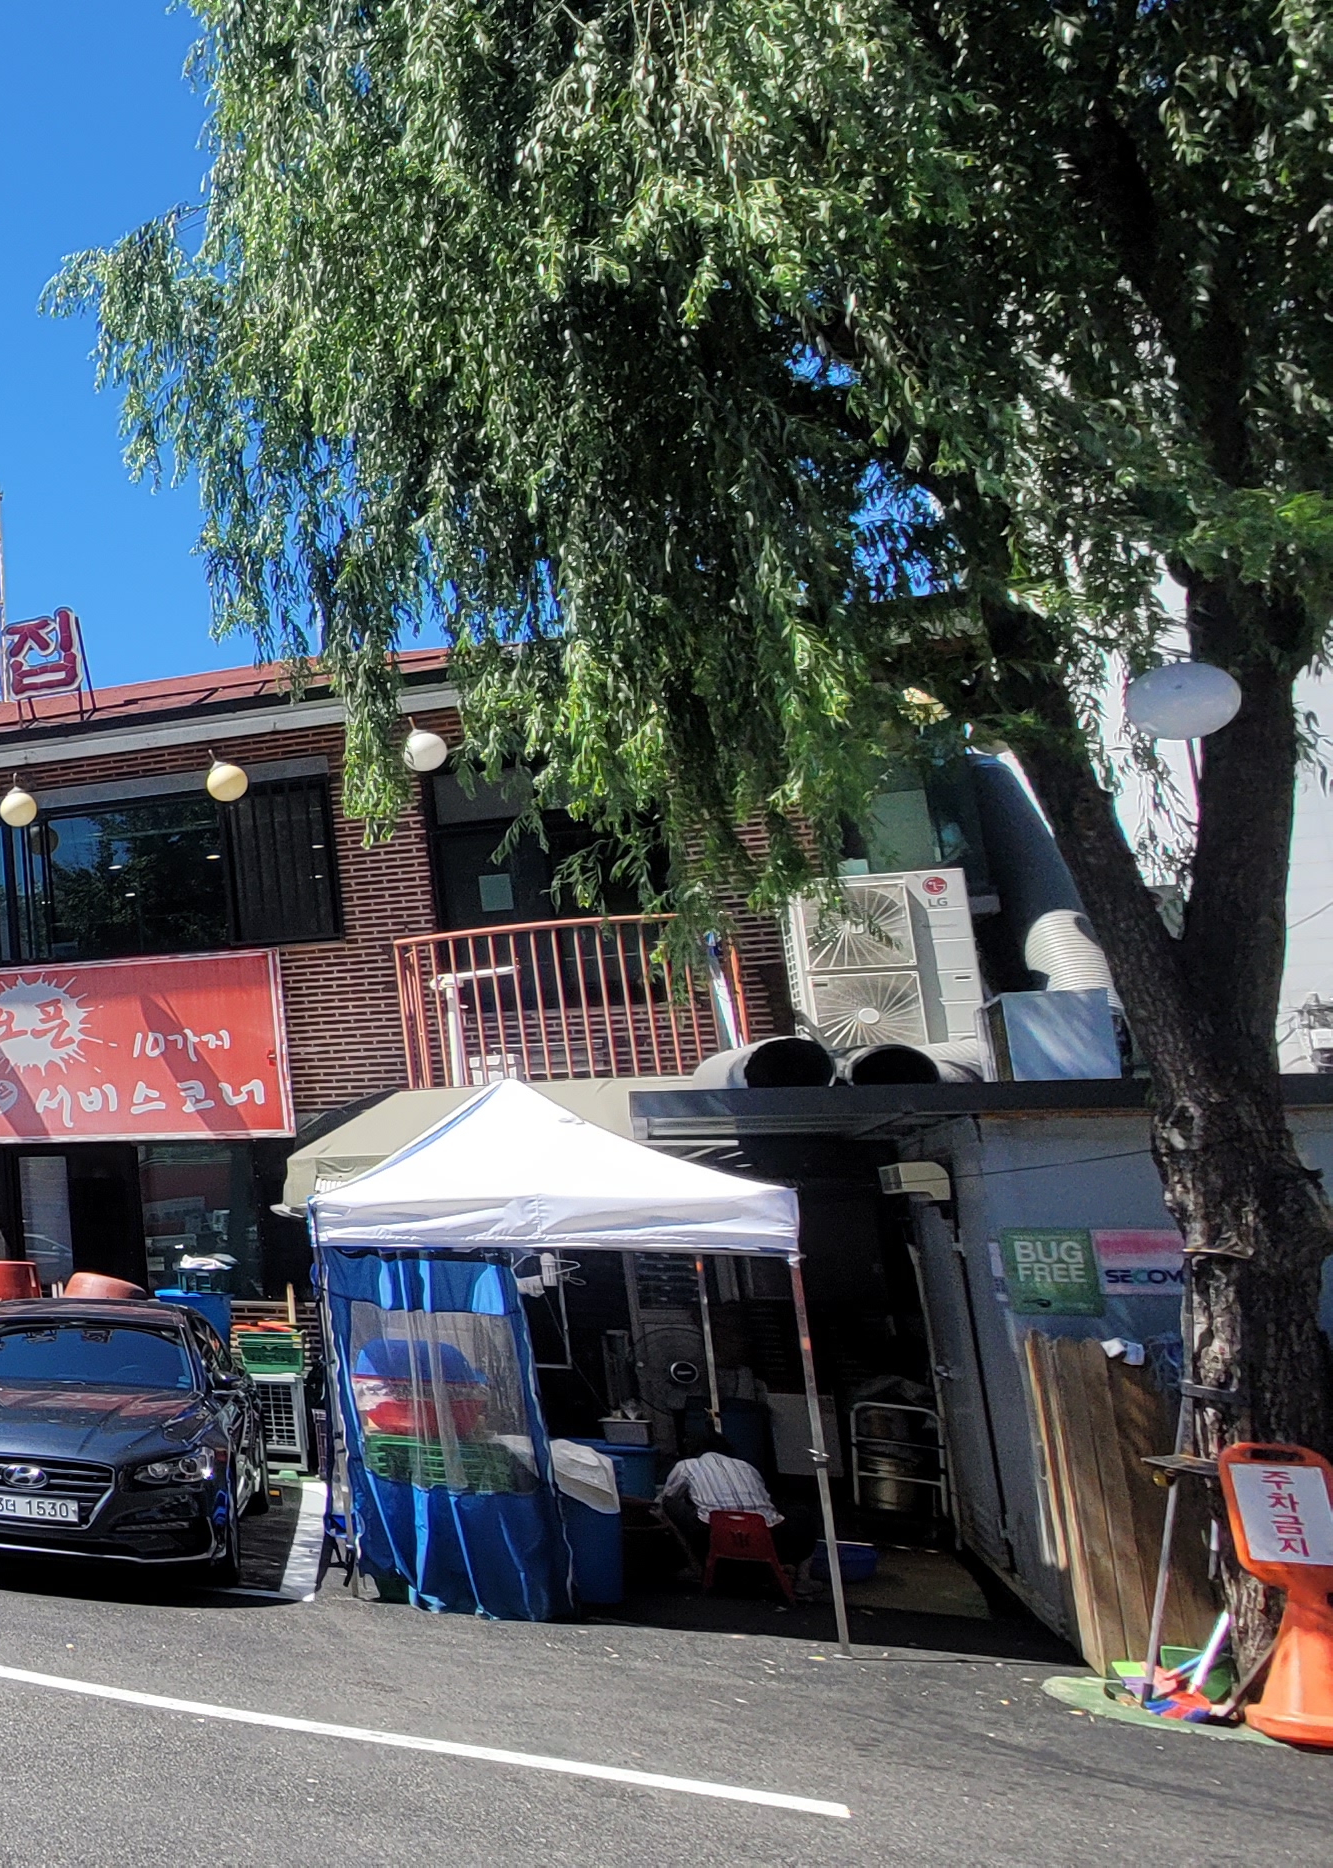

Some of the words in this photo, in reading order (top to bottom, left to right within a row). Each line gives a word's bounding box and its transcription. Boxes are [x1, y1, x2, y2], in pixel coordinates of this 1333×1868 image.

[927, 897, 948, 908] LG
[133, 1028, 231, 1062] 10가지
[35, 1079, 266, 1128] 서비스코너
[1014, 1240, 1083, 1264] BUG
[1017, 1263, 1087, 1283] FREE
[1105, 1269, 1184, 1284] SECOM
[26, 1500, 69, 1518] 1530
[1261, 1470, 1310, 1557] 주차금지
